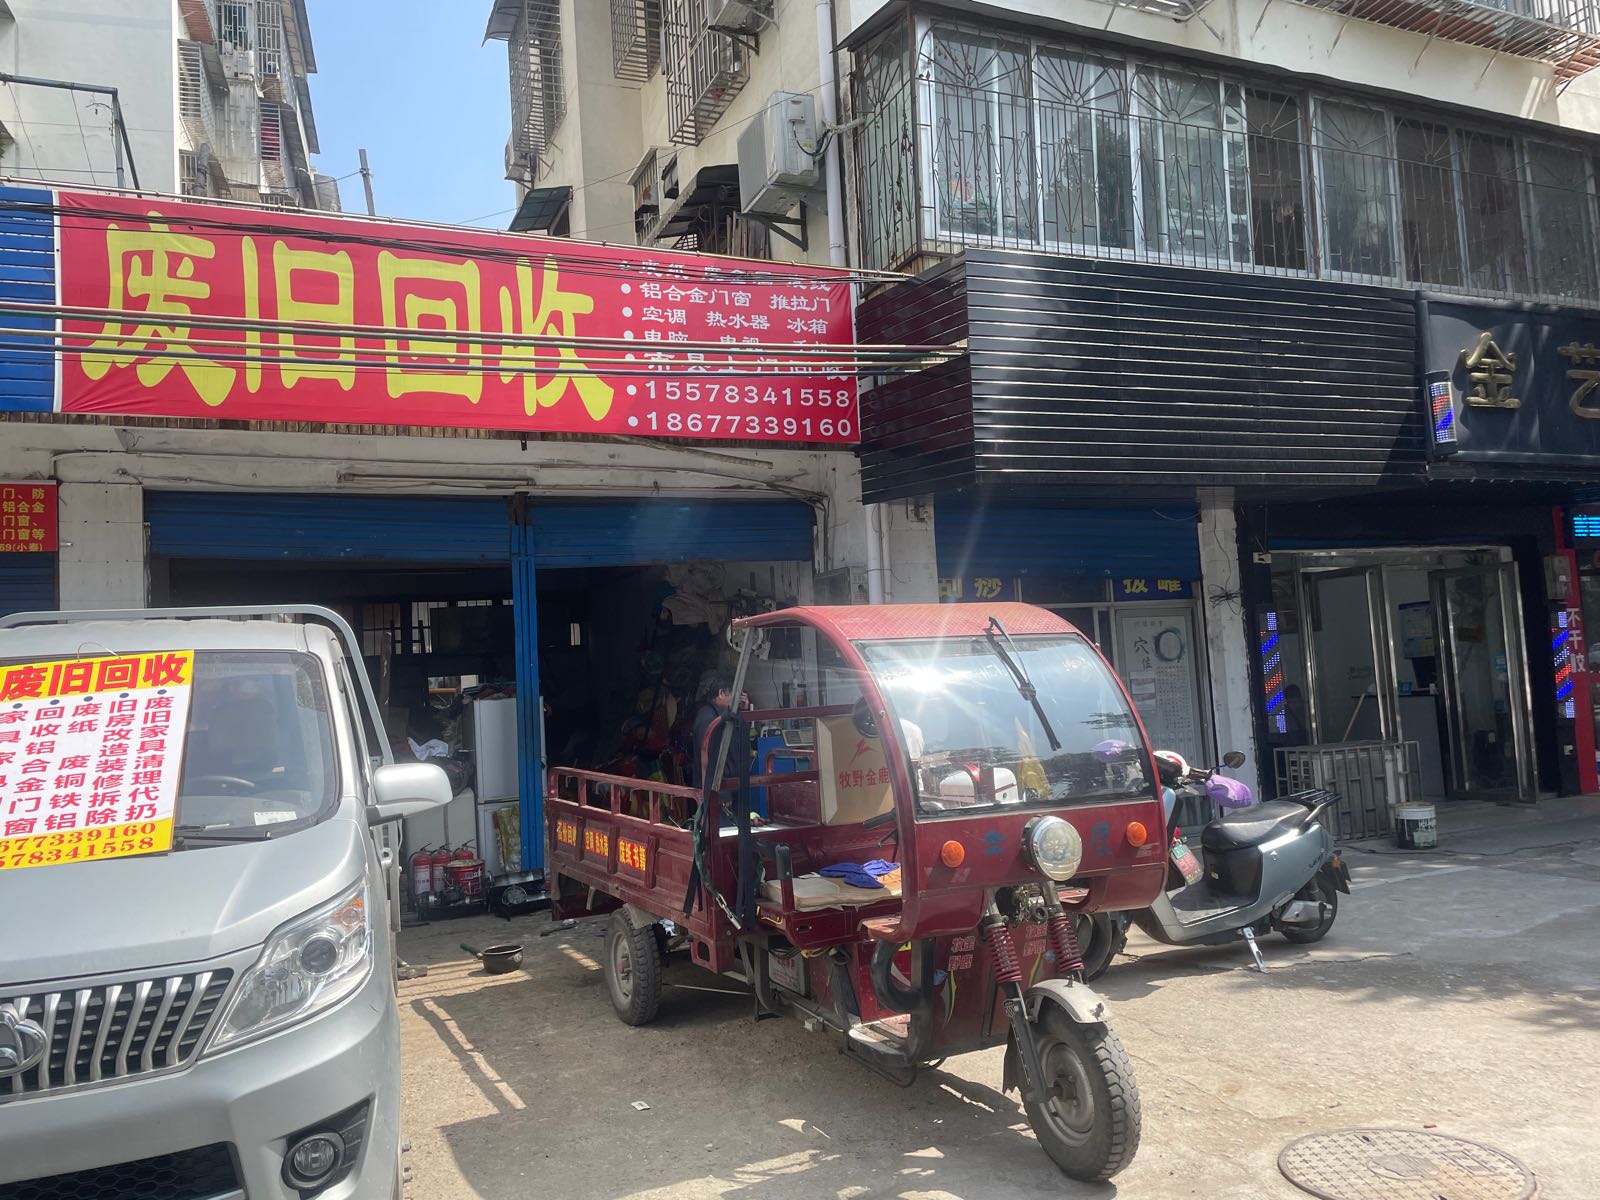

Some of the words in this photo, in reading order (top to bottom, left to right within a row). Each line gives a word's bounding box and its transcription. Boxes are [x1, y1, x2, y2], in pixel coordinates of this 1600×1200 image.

[81, 210, 614, 421] 废旧回收
[639, 282, 752, 307] 铝合金门窗
[770, 294, 831, 313] 推拉门
[641, 306, 687, 325] 空调
[706, 311, 770, 330] 热水器
[787, 318, 829, 334] 冰箱
[644, 380, 850, 408] 15578341558
[646, 411, 852, 437] 18677339160
[2, 501, 45, 513] 铝合金
[1565, 607, 1587, 673] 不干胶
[0, 654, 188, 701] 废旧回收
[67, 703, 103, 734] 废纸
[4, 707, 65, 837] 回收铝合金门窗
[85, 699, 138, 827] 旧房改造装修拆除
[125, 696, 175, 821] 废旧家具清理代扔
[838, 767, 891, 789] 牧野金鹿
[45, 755, 91, 831] 废铜铁铝
